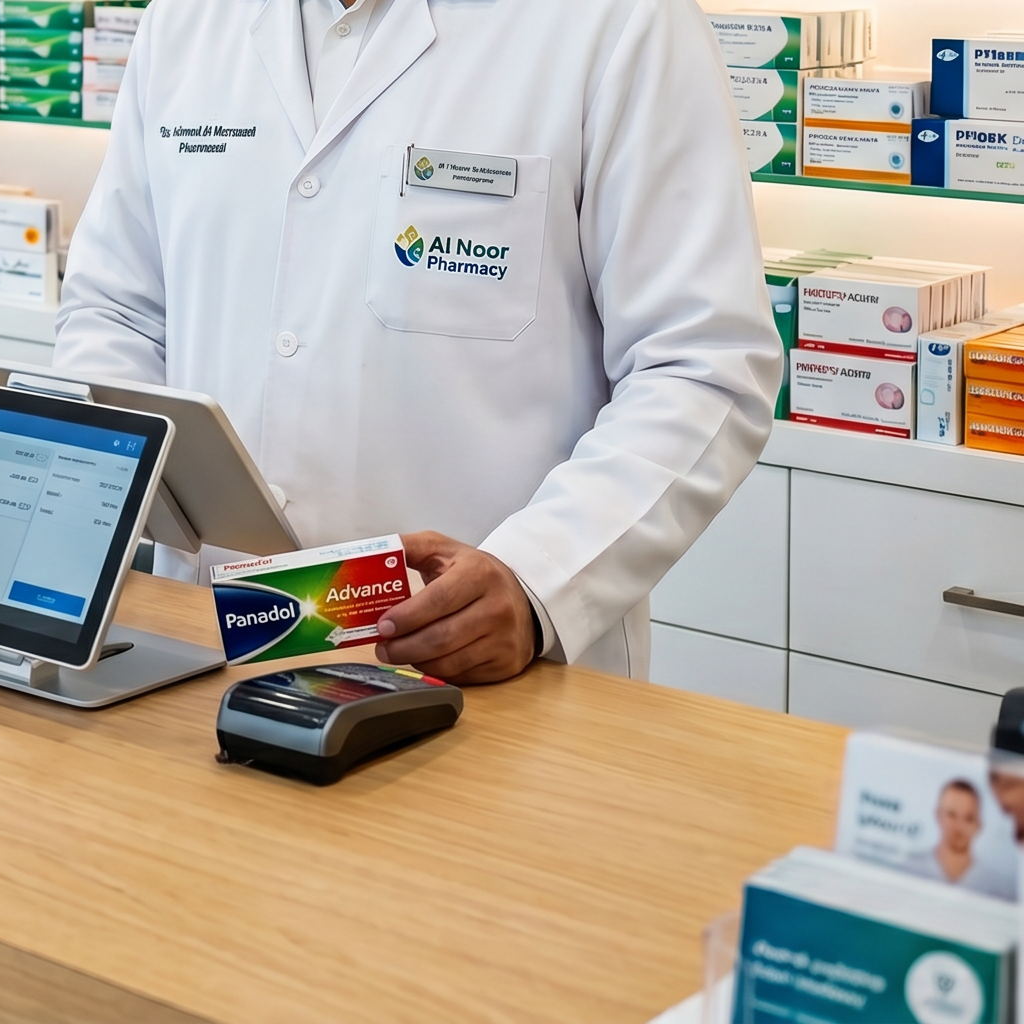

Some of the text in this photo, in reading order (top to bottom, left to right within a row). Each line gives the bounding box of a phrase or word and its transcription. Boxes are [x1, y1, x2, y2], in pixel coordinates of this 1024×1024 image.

[428, 235, 510, 260] Al Noor
[427, 255, 508, 281] Pharmacy
[325, 579, 403, 603] Advance
[225, 602, 296, 629] Panadol
